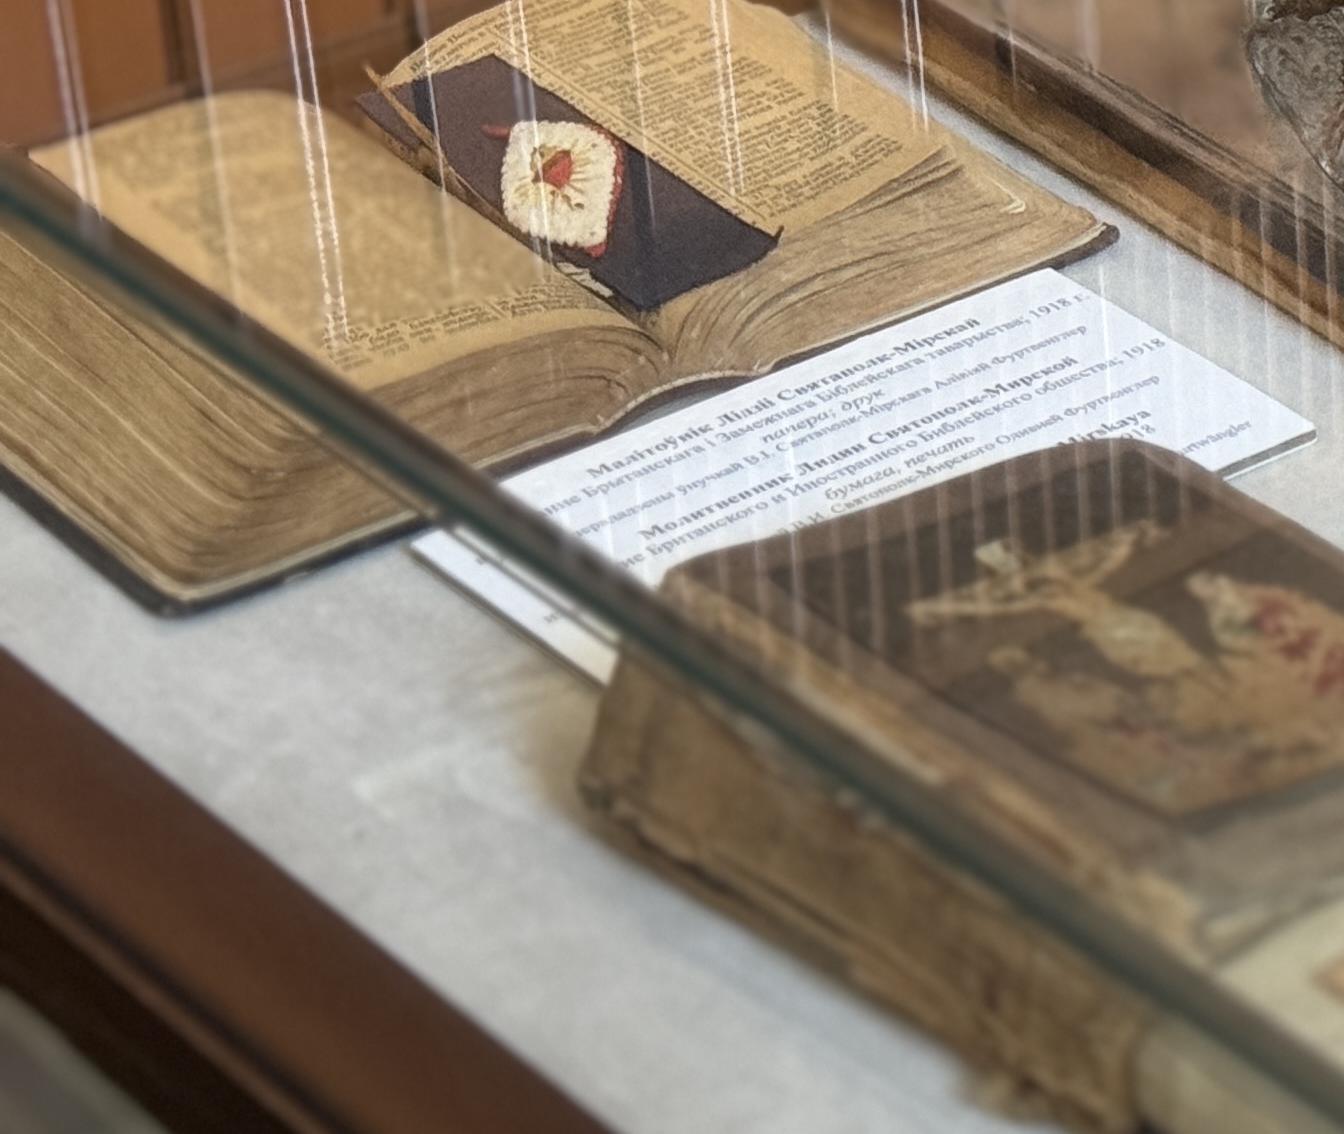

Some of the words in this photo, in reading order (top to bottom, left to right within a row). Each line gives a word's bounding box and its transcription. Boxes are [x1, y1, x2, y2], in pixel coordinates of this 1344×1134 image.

[1028, 297, 1072, 319] 1918
[1121, 337, 1166, 359] 1918
[586, 423, 714, 478] Малітоўнік
[777, 318, 980, 407] Святаполк-Мірскай
[639, 473, 793, 540] Молитвенник
[868, 356, 1078, 445] Святополк-Мирской
